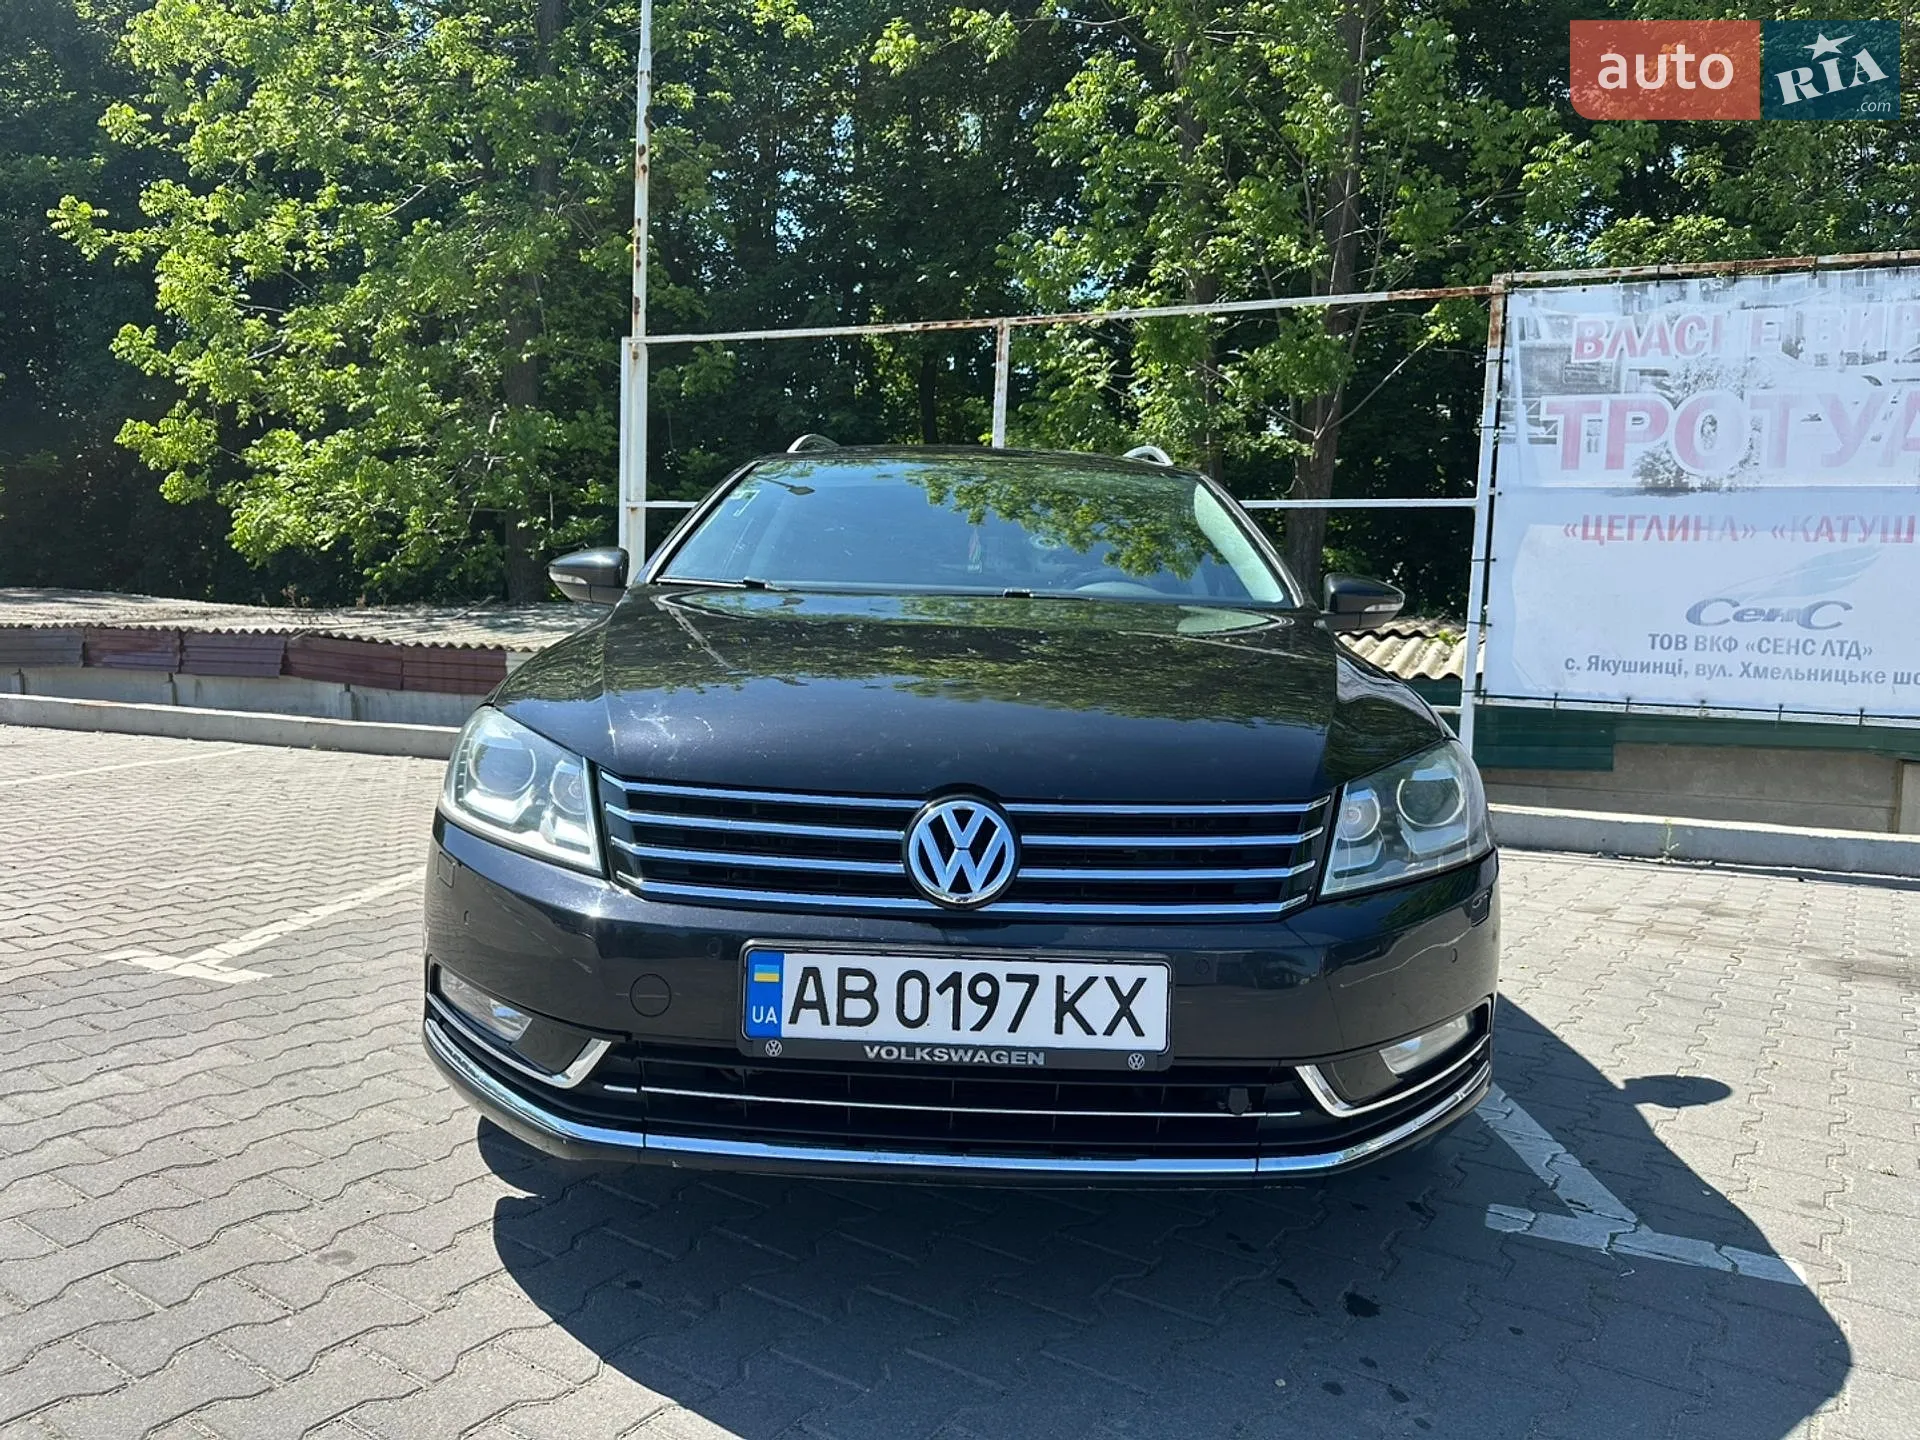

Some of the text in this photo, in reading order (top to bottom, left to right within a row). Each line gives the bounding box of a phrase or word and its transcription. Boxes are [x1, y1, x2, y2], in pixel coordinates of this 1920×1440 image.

[1563, 514, 1757, 545] «ЦЕГЛИНА»
[1648, 633, 1873, 660] ТОВ ВКФ «СЕНС ЛТД»
[1564, 657, 1581, 672] с.
[1586, 655, 1689, 678] Якушинці,
[1695, 663, 1733, 681] вул.
[1739, 661, 1886, 686] Хмельницьке
[752, 1005, 778, 1025] UA
[788, 966, 1147, 1037] AB 0197 KX
[864, 1045, 1045, 1066] VOLKSWAGEN
